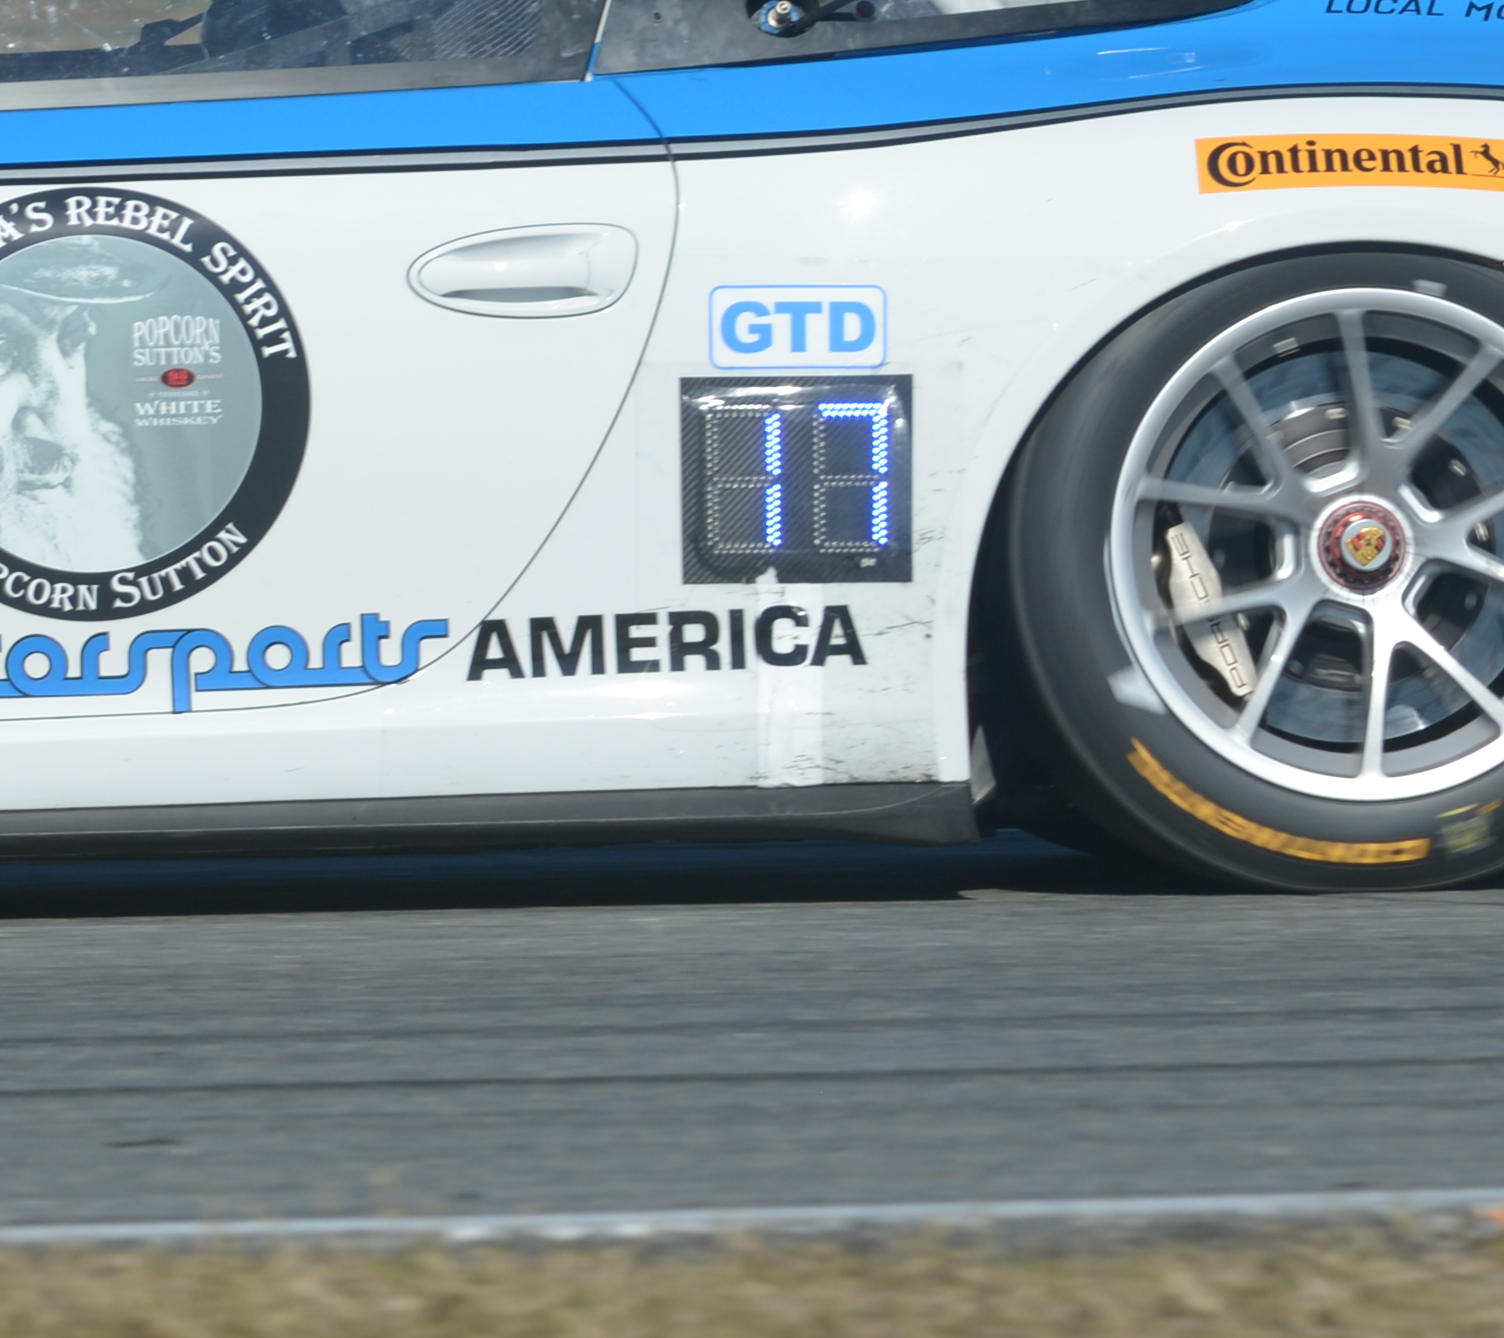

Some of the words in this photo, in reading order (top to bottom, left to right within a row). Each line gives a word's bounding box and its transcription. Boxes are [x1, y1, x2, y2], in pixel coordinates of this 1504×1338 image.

[1206, 140, 1467, 187] Continental
[66, 194, 194, 253] REBEL
[201, 242, 297, 360] SPIRIT
[133, 314, 220, 347] POPCORN
[721, 301, 876, 354] GTD
[134, 399, 223, 415] WHITE
[135, 415, 224, 427] WHISKEY
[110, 521, 248, 608] SUTTON
[466, 604, 867, 681] AMERICA
